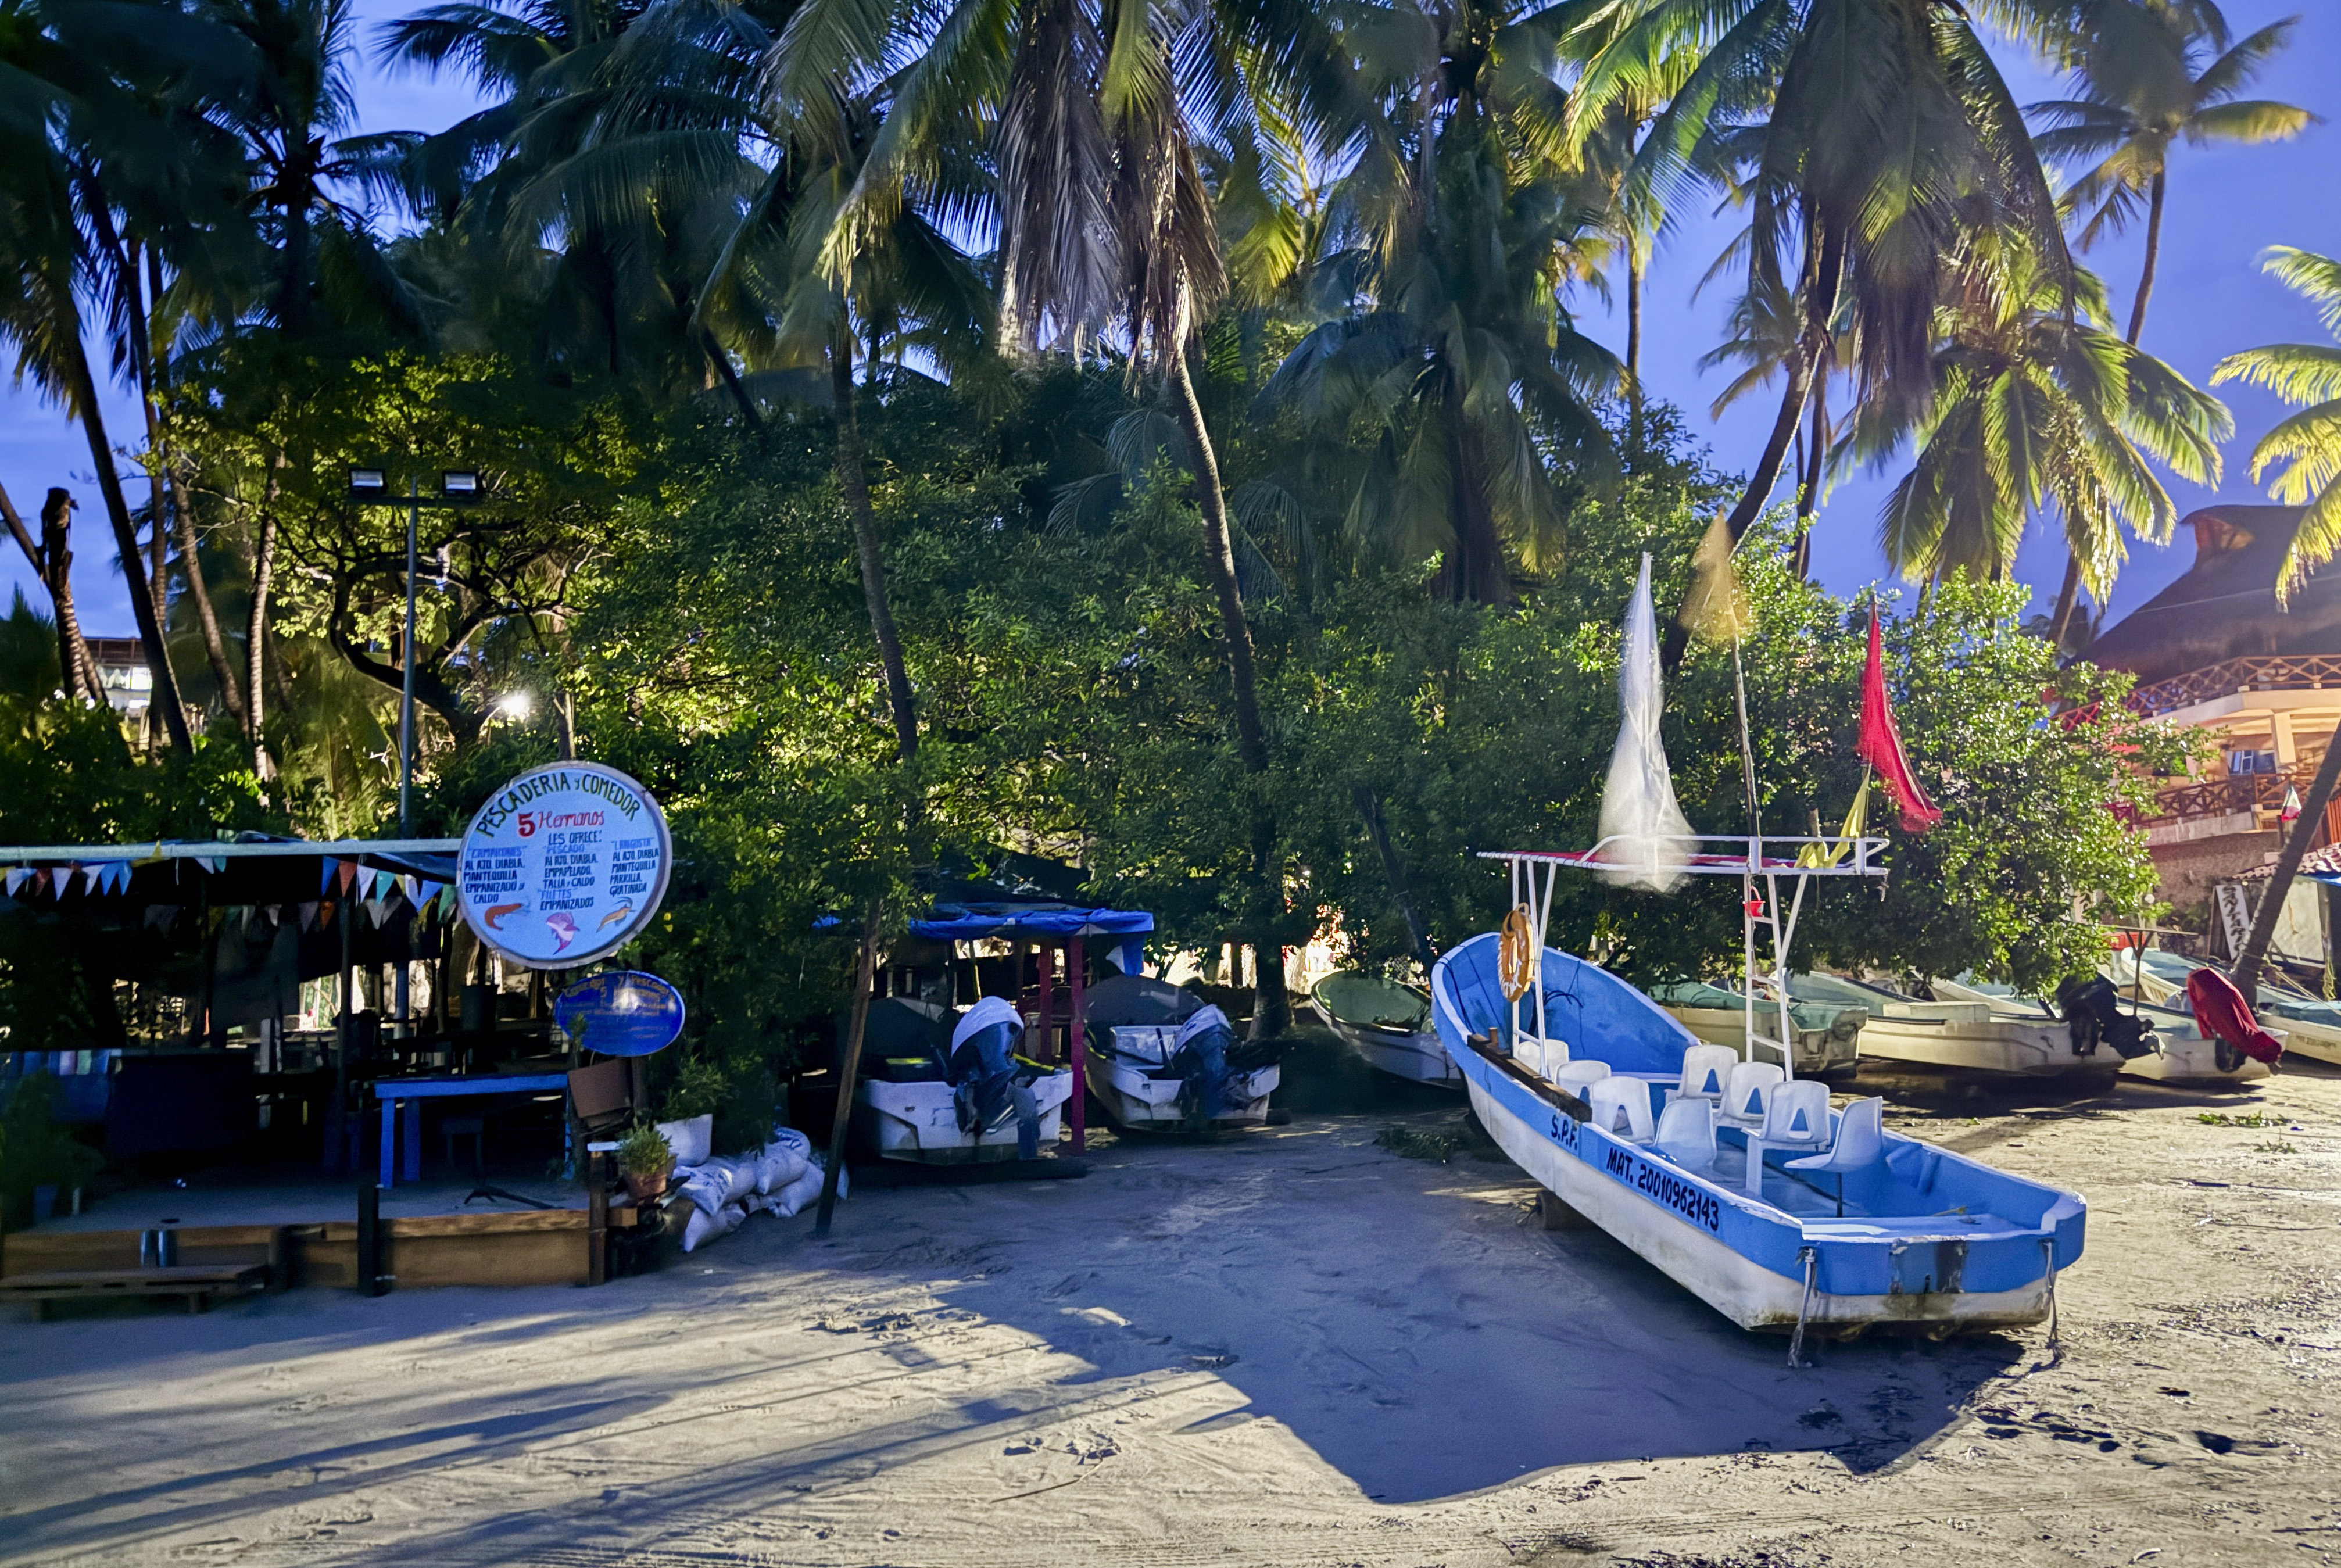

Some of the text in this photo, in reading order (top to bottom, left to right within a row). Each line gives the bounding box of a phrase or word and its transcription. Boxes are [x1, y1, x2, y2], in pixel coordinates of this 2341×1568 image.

[475, 771, 571, 838] PESCADERIA
[582, 773, 640, 821] COMEDOR
[518, 810, 604, 837] 5 Hermanos
[548, 833, 565, 845] LES
[545, 856, 552, 866] AL
[613, 851, 620, 861] AL
[465, 861, 474, 870] AL
[464, 870, 517, 882] MANTEQUILLA
[543, 878, 565, 889] TALLA
[571, 876, 595, 887] CALDO
[466, 880, 517, 893] EMPANIZADO
[474, 893, 499, 904] CALDO
[540, 897, 594, 910] EMPANIZADOS
[1551, 1114, 1578, 1150] S.P.F.
[1606, 1147, 1719, 1231] MAT. 20010962143
